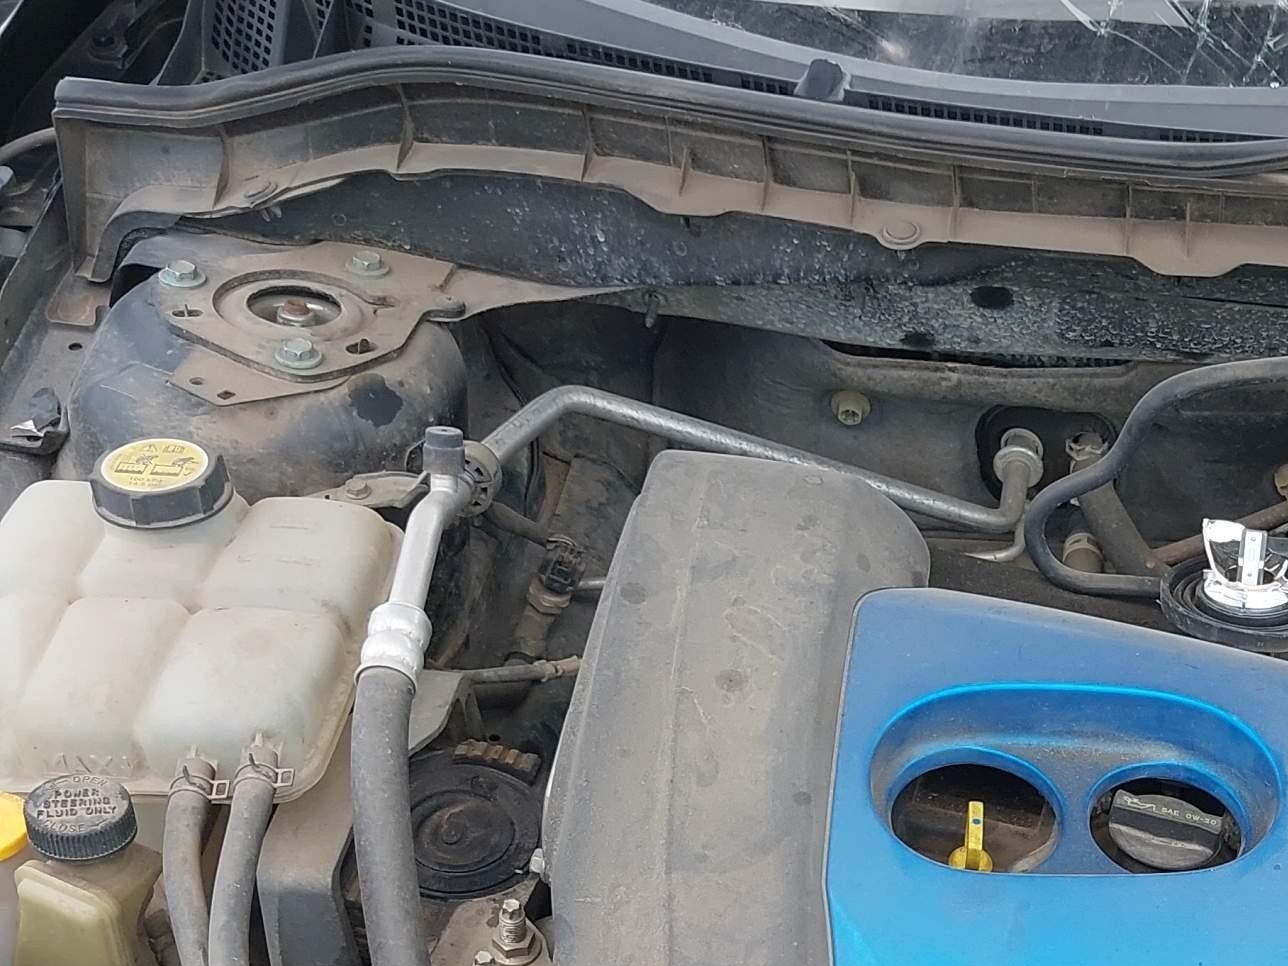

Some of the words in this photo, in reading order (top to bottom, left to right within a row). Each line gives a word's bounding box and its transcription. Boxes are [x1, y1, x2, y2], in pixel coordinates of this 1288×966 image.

[72, 776, 108, 786] OPEN
[54, 788, 100, 800] POWER
[42, 796, 111, 809] STEERING
[36, 807, 78, 819] FLUID
[85, 806, 117, 816] ONLY
[1162, 807, 1180, 816] SAE
[43, 820, 86, 832] CLOSE
